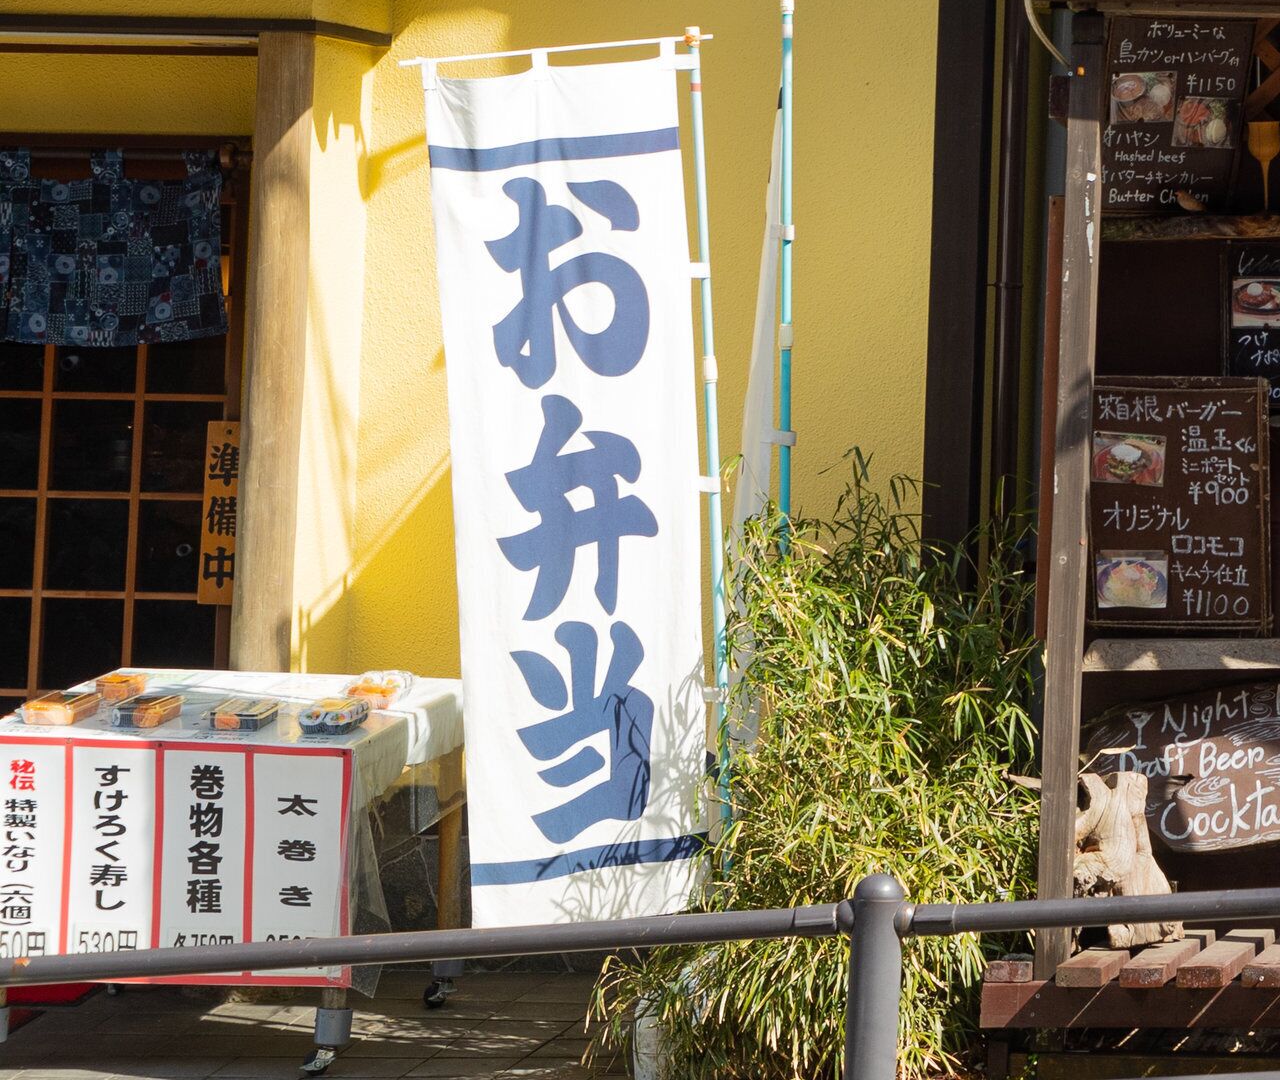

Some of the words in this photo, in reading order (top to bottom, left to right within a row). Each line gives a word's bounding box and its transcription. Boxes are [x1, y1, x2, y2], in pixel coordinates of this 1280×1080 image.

[1147, 20, 1226, 40] ボリューミーな
[1186, 73, 1237, 94] ¥1150
[1115, 150, 1155, 163] Hashed
[1157, 149, 1187, 164] beef
[1109, 188, 1155, 204] Butter
[1238, 331, 1269, 346] つけ
[1181, 425, 1257, 454] 温玉くん
[1182, 456, 1242, 475] ミニポテト
[1215, 472, 1251, 486] セット
[1188, 481, 1250, 506] ¥900
[200, 442, 240, 590] 準備中
[483, 175, 660, 845] お弁当
[1102, 500, 1190, 532] オリジナル
[1171, 534, 1245, 557] ロコモコ
[1171, 560, 1250, 587] キムチ仕立
[1182, 588, 1250, 617] ¥1100
[1160, 687, 1254, 743] Night
[9, 758, 36, 792] 秘伝
[1197, 742, 1267, 780] Beer
[89, 764, 131, 911] すけろく寿し
[186, 764, 226, 915] 巻物各種
[277, 793, 319, 909] 太巻き
